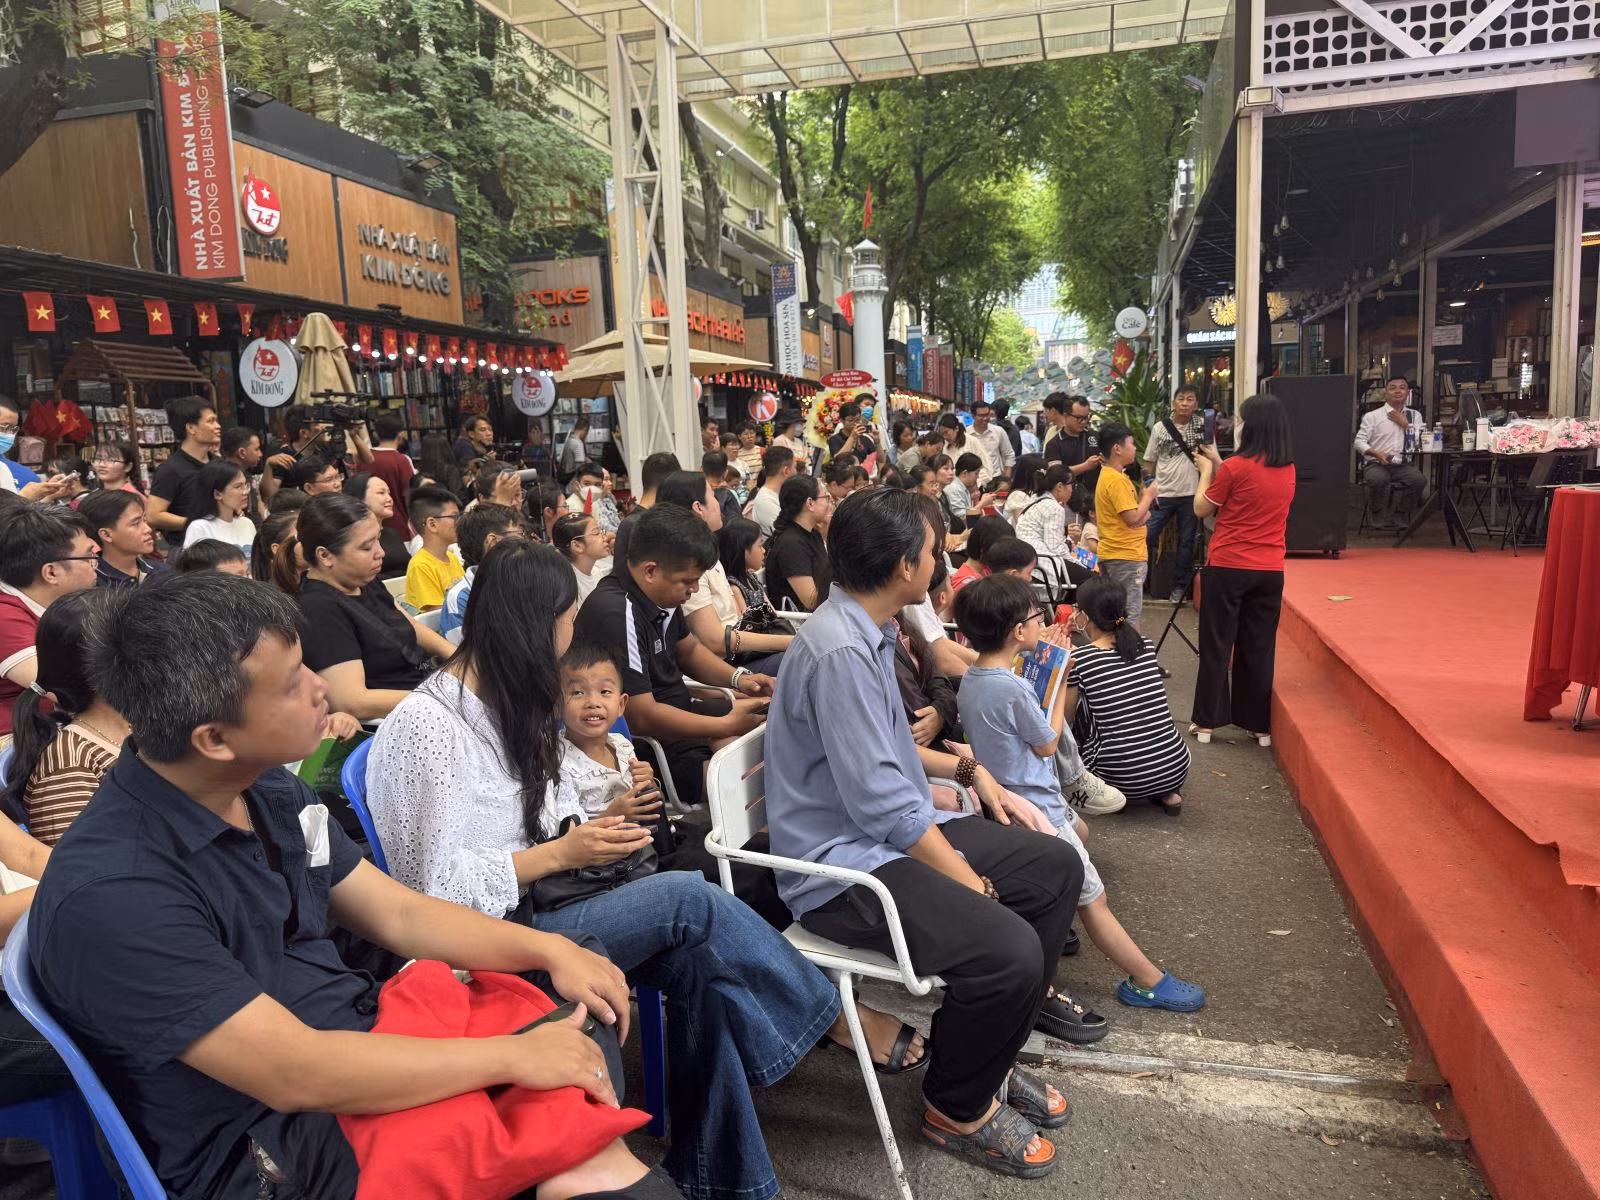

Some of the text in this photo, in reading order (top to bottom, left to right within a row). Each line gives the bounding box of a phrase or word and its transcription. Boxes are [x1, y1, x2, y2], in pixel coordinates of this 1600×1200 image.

[179, 92, 194, 127] KIM
[196, 85, 218, 178] PUBLISHING
[182, 133, 198, 172] BẢN
[184, 177, 205, 225] XUẤT
[206, 183, 223, 236] DONG
[191, 228, 209, 270] NHÀ
[212, 242, 226, 268] KIM
[358, 224, 390, 252] NHÀ
[361, 254, 451, 296] KIM ĐỒNG
[251, 380, 264, 394] KIM
